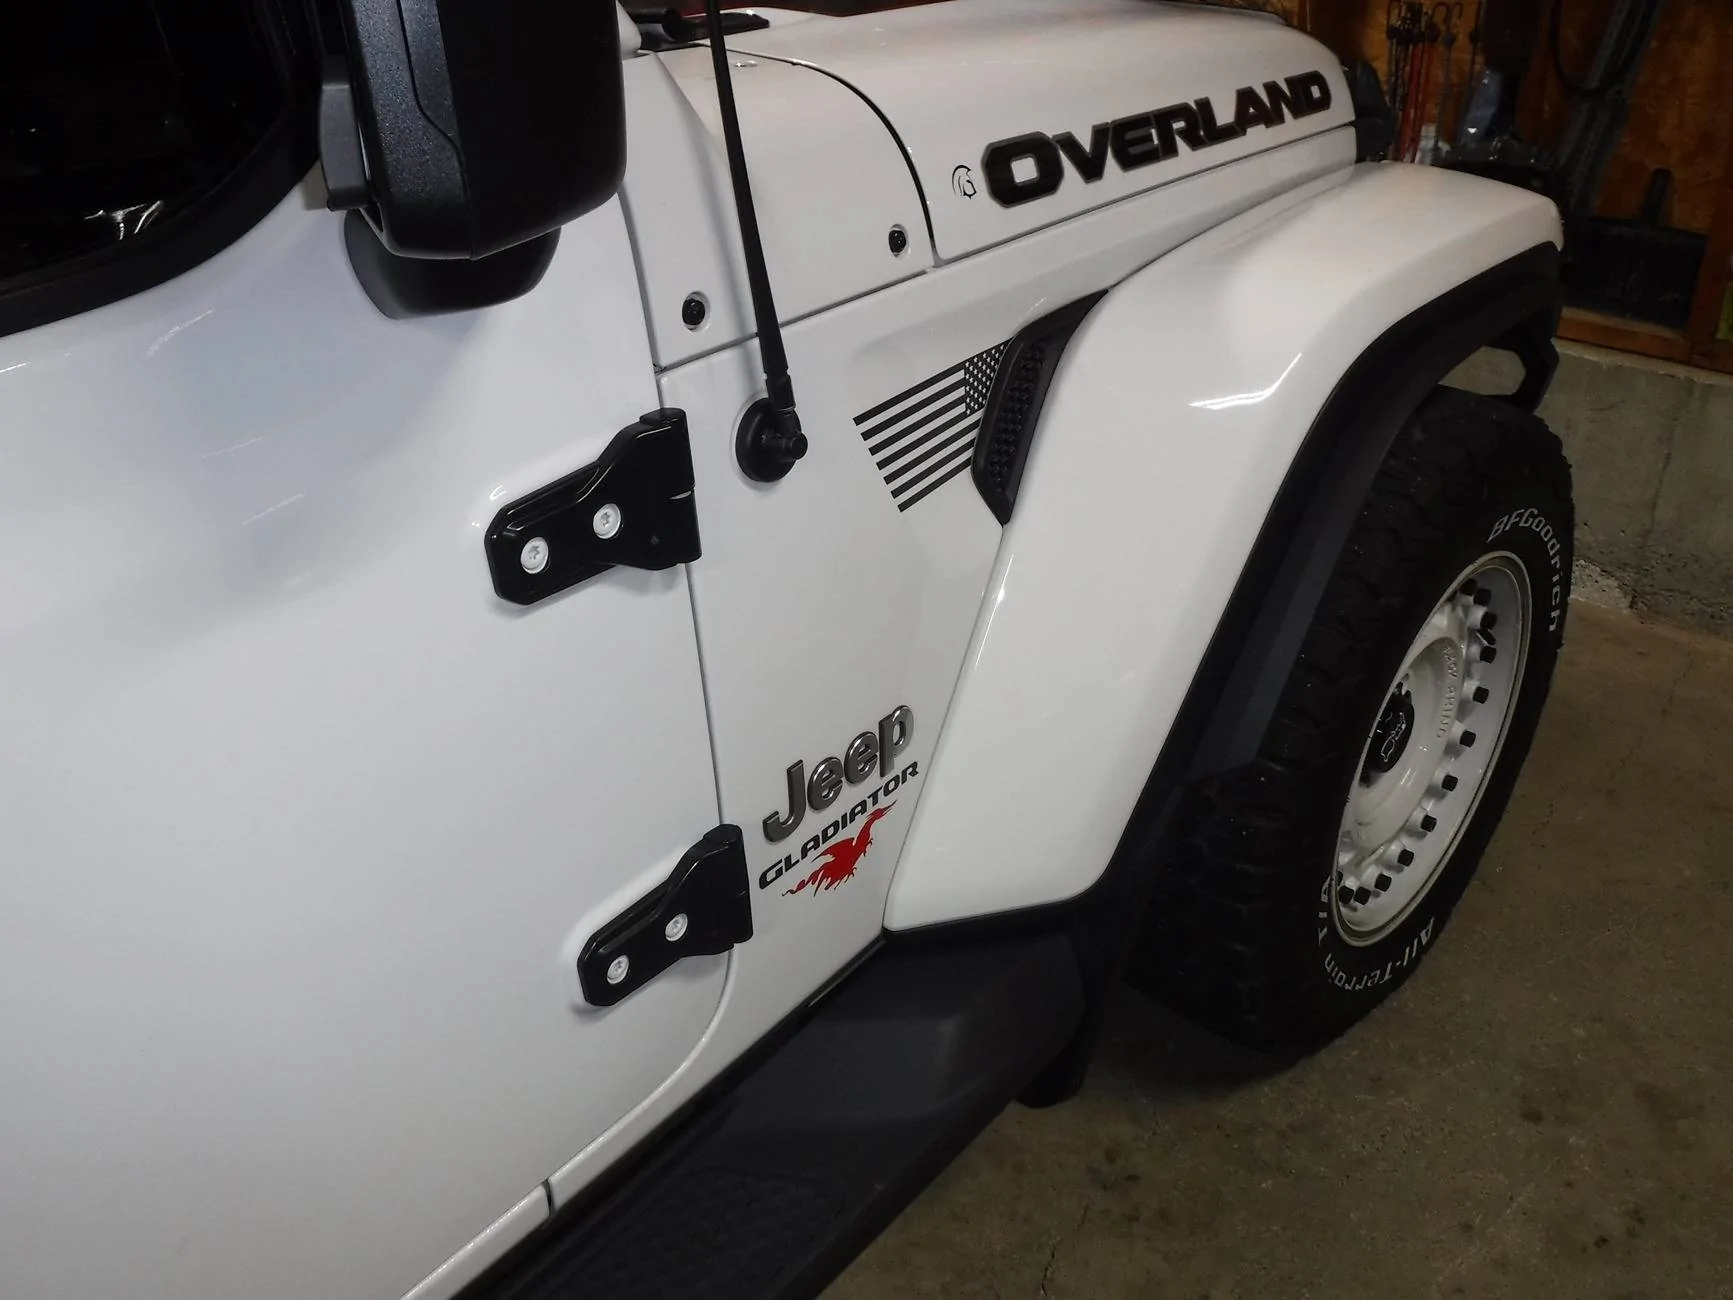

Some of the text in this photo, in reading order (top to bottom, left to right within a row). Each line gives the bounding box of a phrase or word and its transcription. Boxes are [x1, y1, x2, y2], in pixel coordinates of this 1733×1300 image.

[981, 70, 1332, 209] OVERLAND
[1486, 507, 1563, 632] BFGoodrich
[758, 761, 919, 890] GLADIATOR
[762, 704, 915, 843] Jeep
